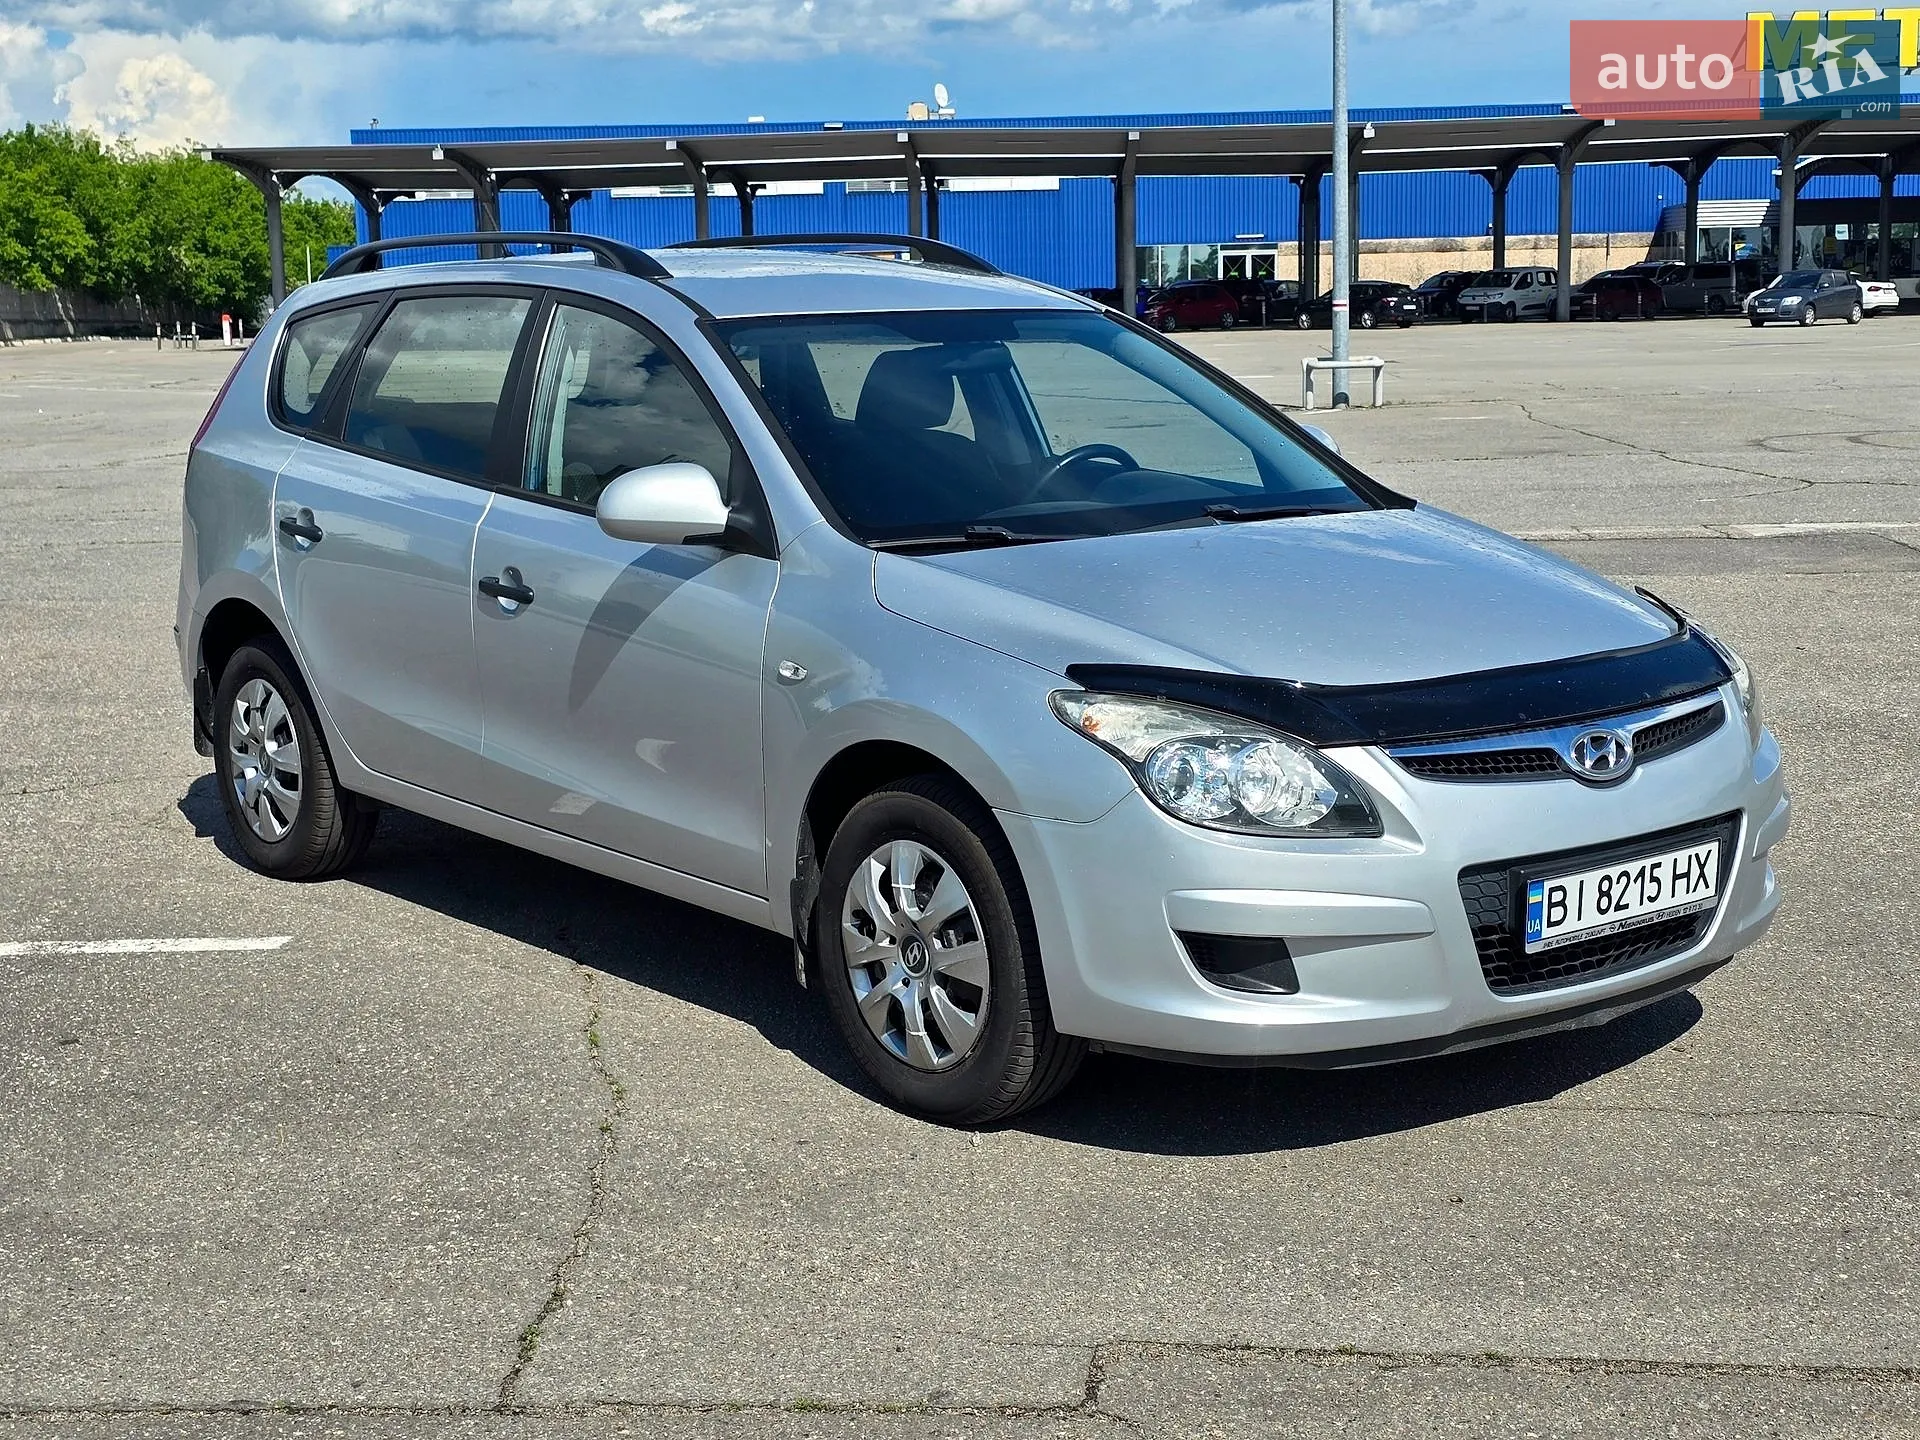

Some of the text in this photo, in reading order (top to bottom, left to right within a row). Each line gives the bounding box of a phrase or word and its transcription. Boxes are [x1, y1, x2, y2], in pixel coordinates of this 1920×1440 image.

[1546, 849, 1713, 929] BI 8215 HX
[1527, 919, 1541, 933] UA
